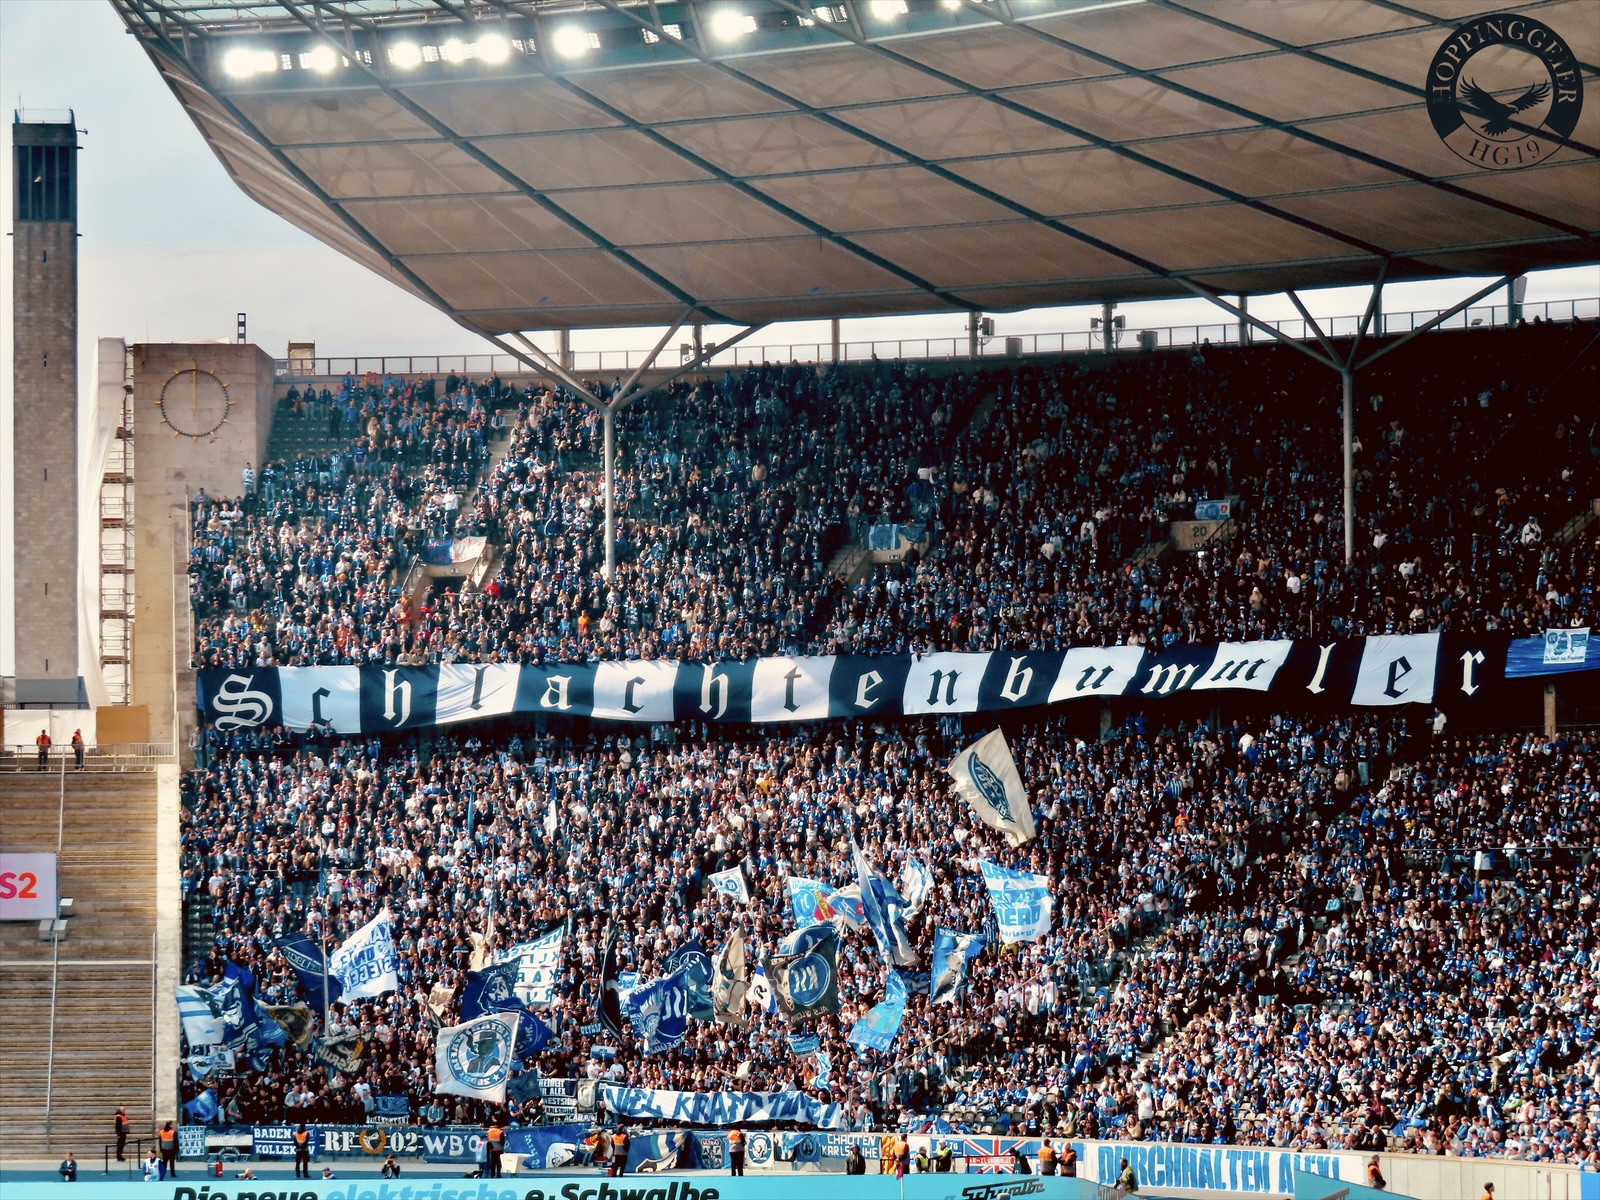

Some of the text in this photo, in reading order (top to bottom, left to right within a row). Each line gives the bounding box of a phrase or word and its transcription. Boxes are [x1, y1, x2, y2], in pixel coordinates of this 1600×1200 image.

[1192, 526, 1207, 537] 20
[213, 642, 1485, 732] Schlachtenbummler
[672, 1091, 762, 1124] KRAFT
[254, 1128, 292, 1139] BADEN
[324, 1131, 418, 1152] RF 02
[827, 1134, 876, 1146] CHAOTEN
[255, 1144, 315, 1155] KOLLEKV
[822, 1145, 878, 1158] KARLSHE
